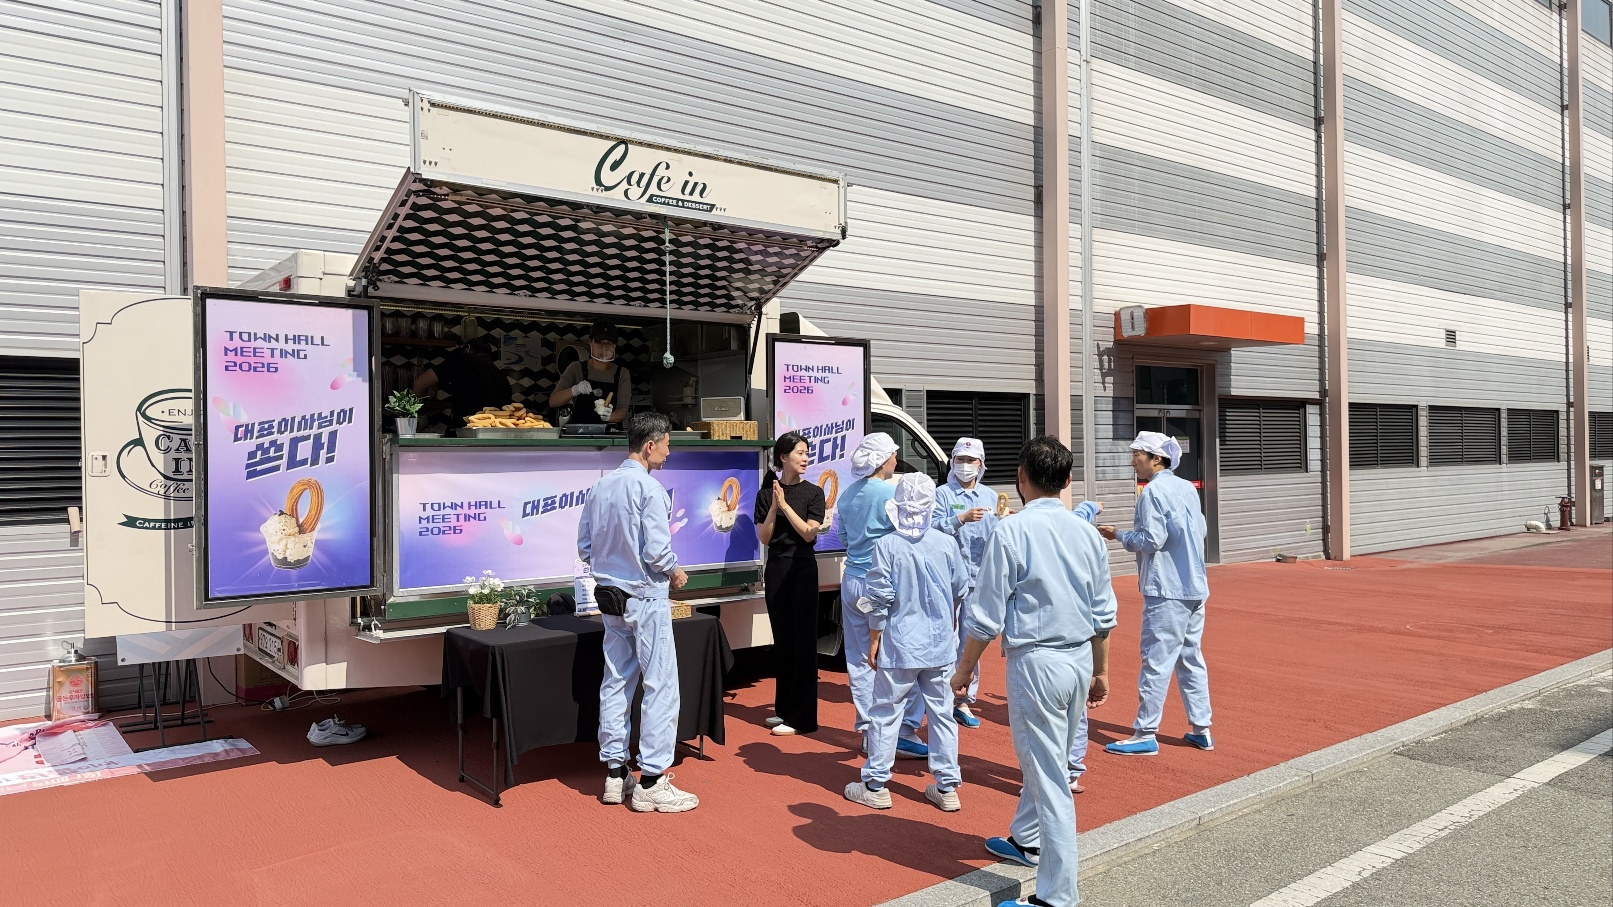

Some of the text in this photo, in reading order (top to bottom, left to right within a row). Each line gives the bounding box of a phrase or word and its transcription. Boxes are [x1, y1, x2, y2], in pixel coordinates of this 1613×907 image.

[594, 140, 712, 201] Cafe in
[652, 196, 677, 206] COFFEE
[684, 201, 711, 211] DESSERT
[224, 330, 331, 347] TOWN HALL
[223, 345, 308, 360] MEETING
[224, 360, 279, 373] 2026
[783, 363, 843, 375] TOWN HALL
[783, 374, 830, 385] MEETING
[783, 385, 814, 394] 2026
[168, 408, 194, 417] ENJ
[232, 406, 355, 443] 대표이사님이
[154, 433, 193, 455] CA
[244, 429, 339, 482] 쏜다!
[149, 479, 190, 496] Coffee
[418, 499, 506, 513] TOWN HALL
[521, 487, 592, 519] 대표이사
[136, 520, 184, 529] CAFFEINE
[418, 512, 487, 525] MEETING
[418, 525, 463, 537] 2026
